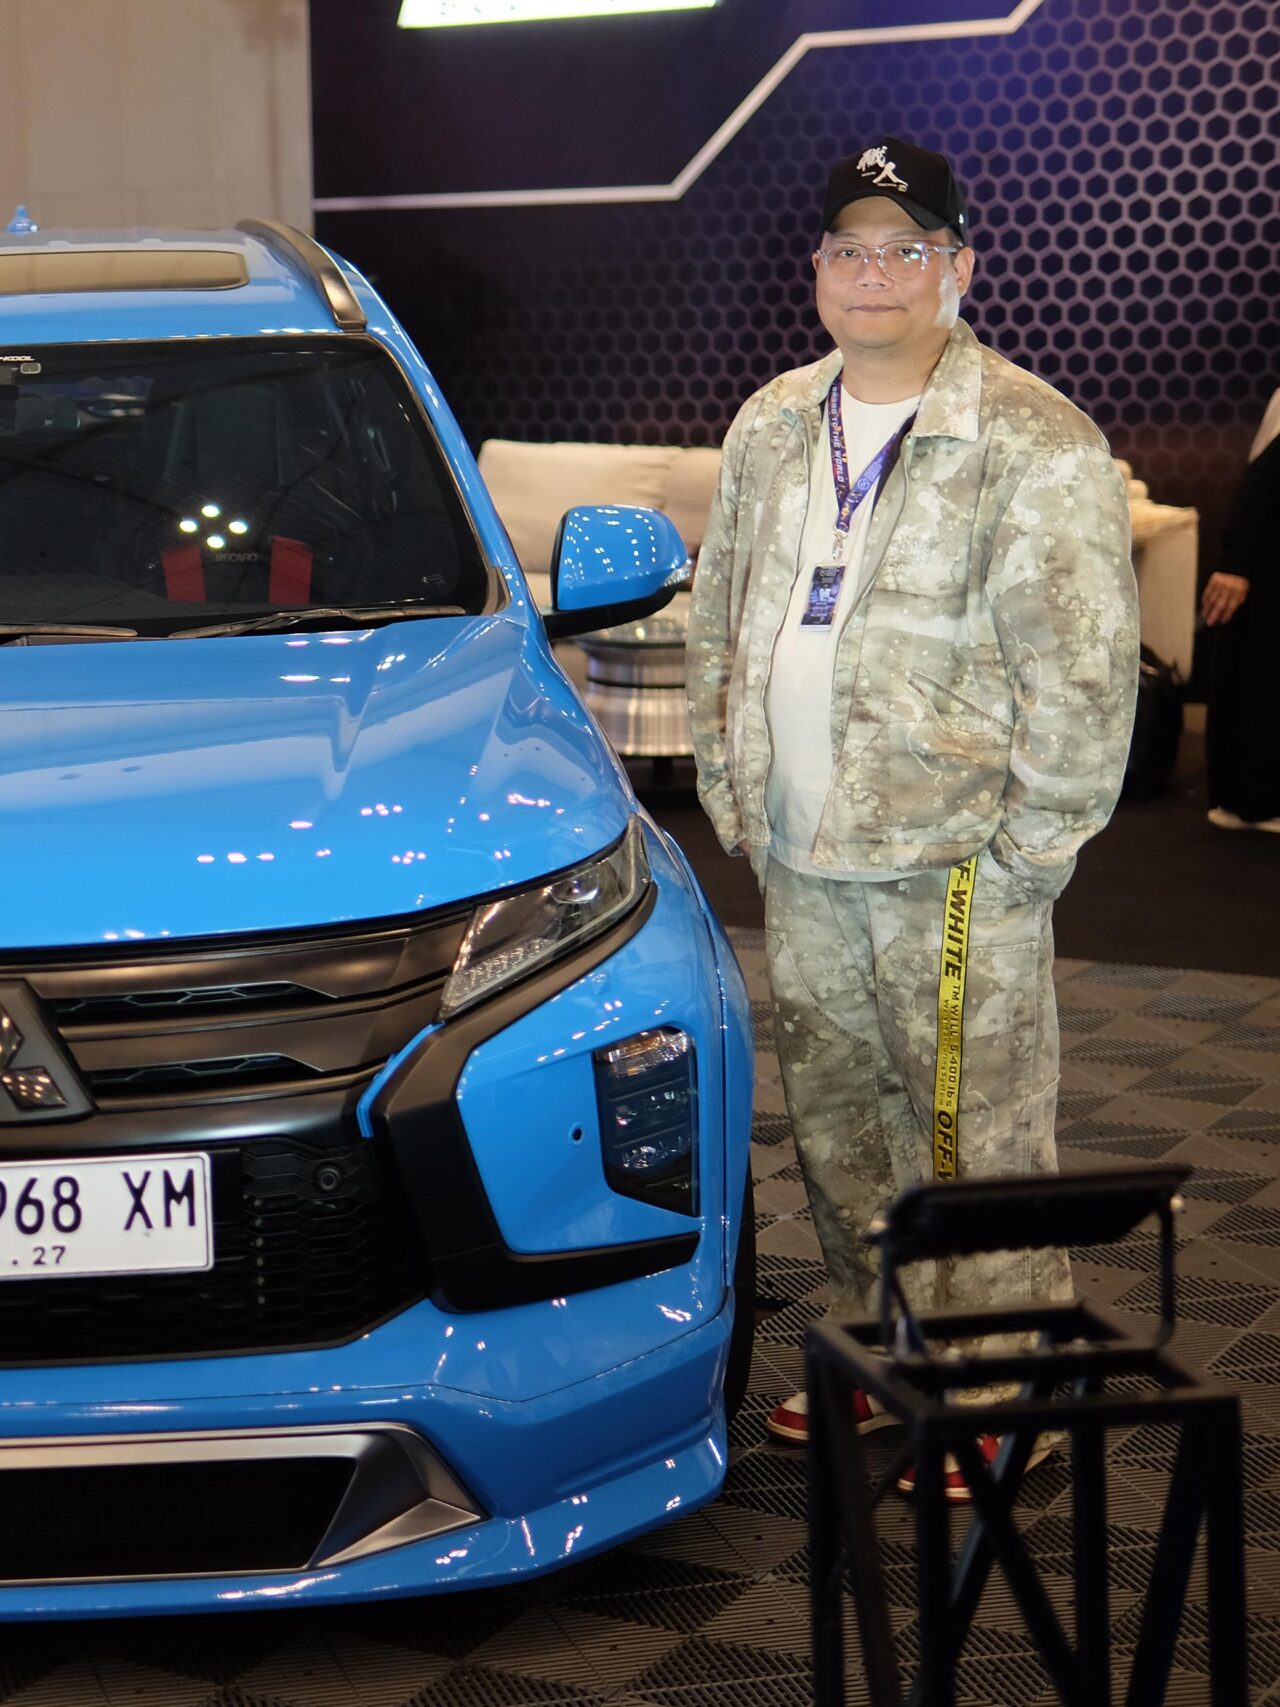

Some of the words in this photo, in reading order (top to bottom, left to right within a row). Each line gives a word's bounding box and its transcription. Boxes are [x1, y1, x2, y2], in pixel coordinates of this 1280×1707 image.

[834, 450, 845, 482] WORLD
[944, 860, 972, 982] F-WHITE
[120, 1167, 197, 1231] XM
